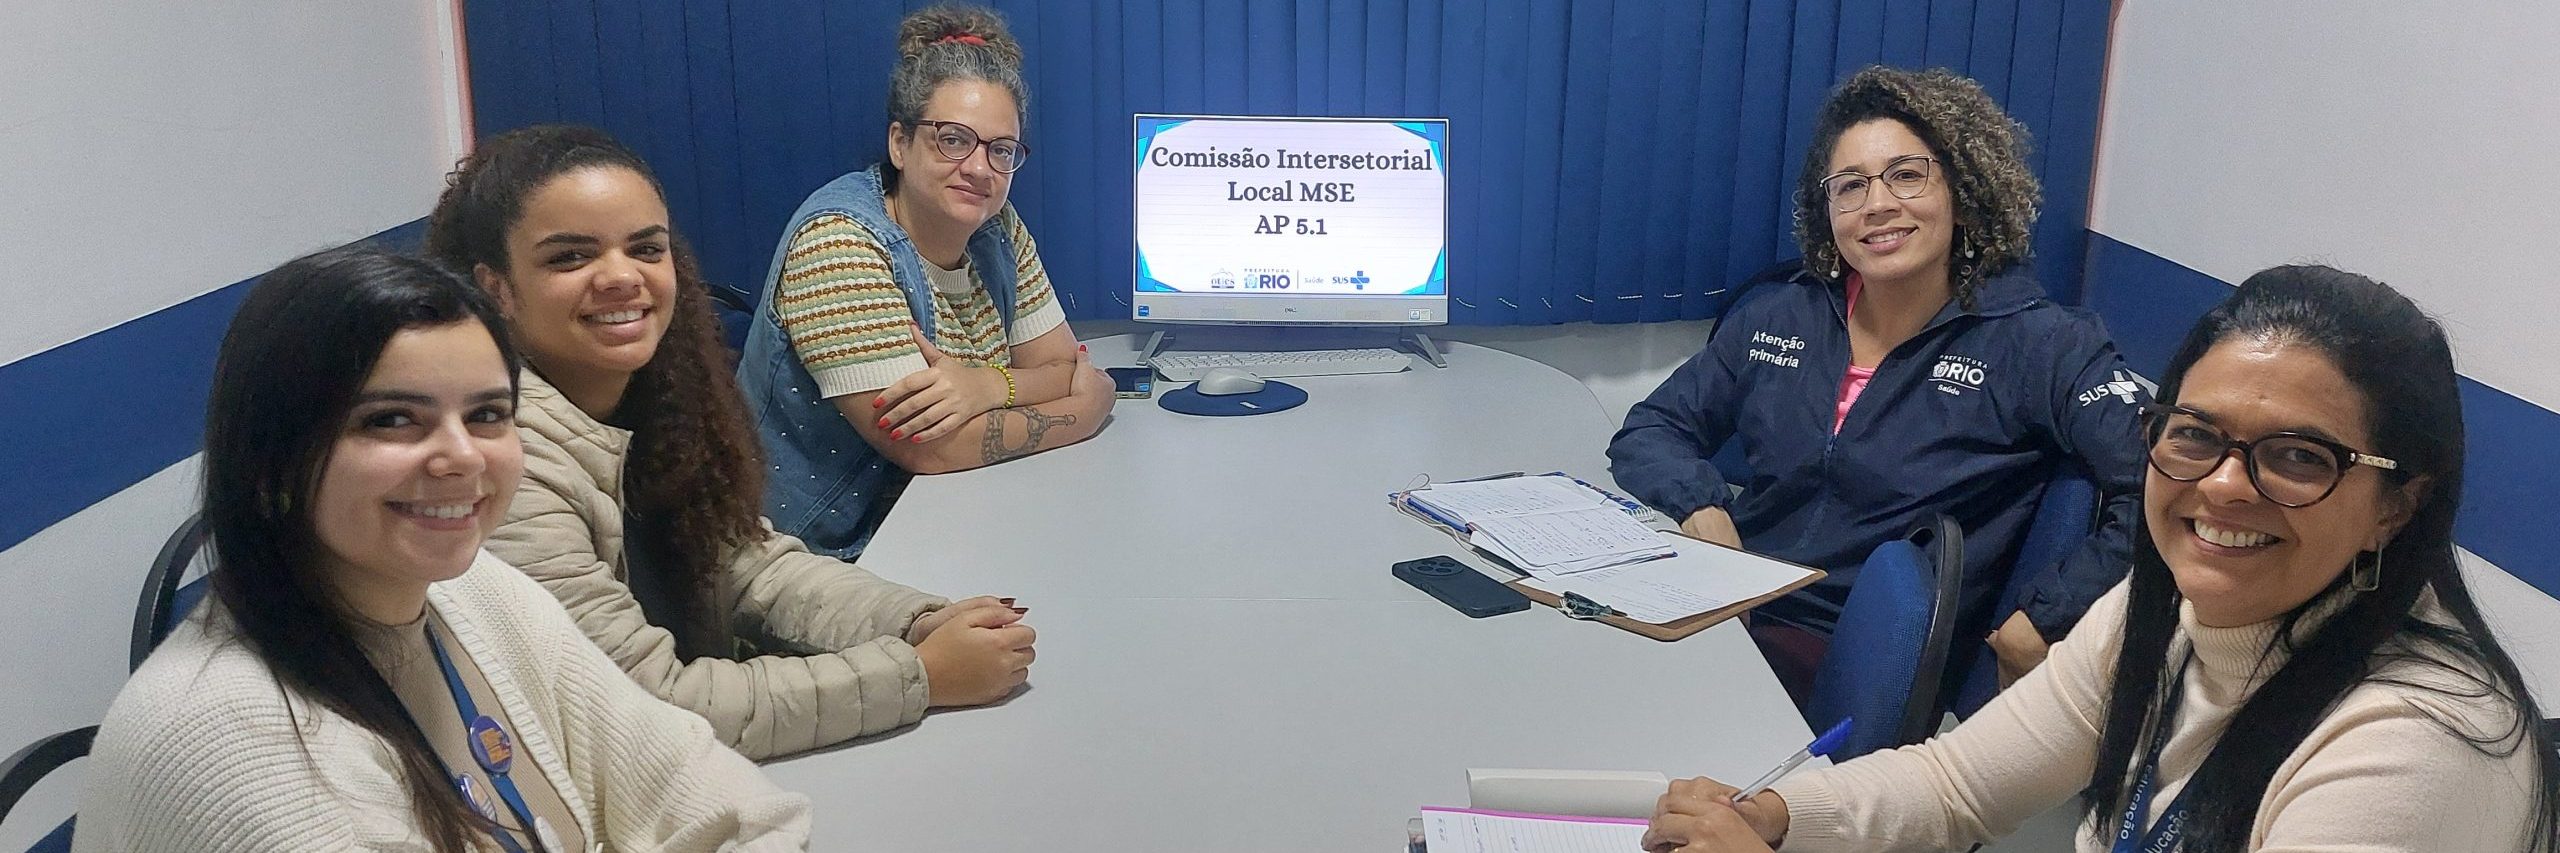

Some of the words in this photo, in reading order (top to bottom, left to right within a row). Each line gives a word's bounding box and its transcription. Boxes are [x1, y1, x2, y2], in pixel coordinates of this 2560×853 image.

[1151, 146, 1270, 170] Comissão
[1276, 148, 1433, 171] Intersetorial
[1227, 179, 1293, 202] Local
[1299, 182, 1355, 203] MSE
[1254, 215, 1290, 235] AP
[1296, 218, 1328, 235] 5.1
[1259, 274, 1291, 289] RIO
[1332, 276, 1349, 284] SUS
[1751, 330, 1806, 352] Atenção
[1748, 349, 1800, 368] Primária
[1939, 354, 1989, 370] PREFEITURA
[1946, 362, 1985, 386] RIO
[1937, 384, 1961, 396] Saúde
[2078, 384, 2110, 407] SUS
